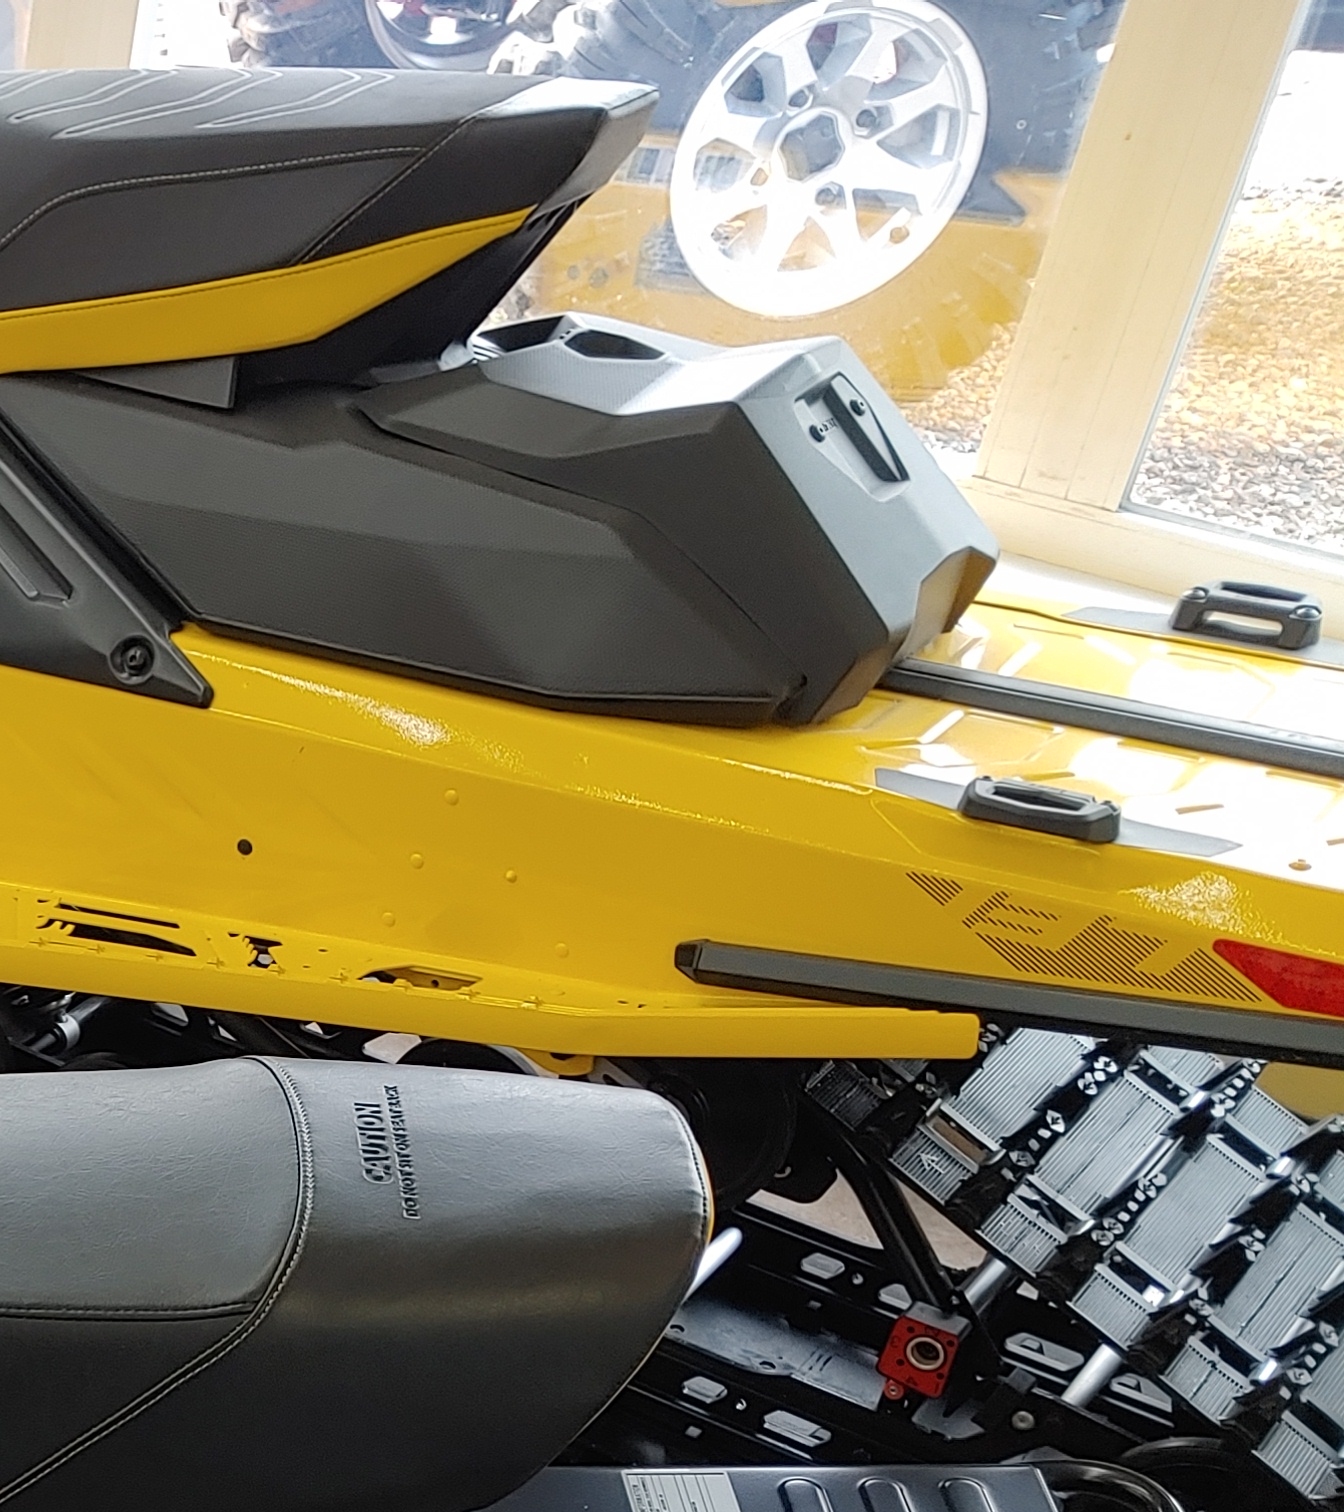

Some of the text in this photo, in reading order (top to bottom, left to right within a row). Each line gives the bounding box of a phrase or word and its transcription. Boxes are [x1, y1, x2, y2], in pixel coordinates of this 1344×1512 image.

[354, 1102, 394, 1184] CAUTION
[399, 1170, 417, 1197] NOT
[402, 1199, 420, 1219] DO
